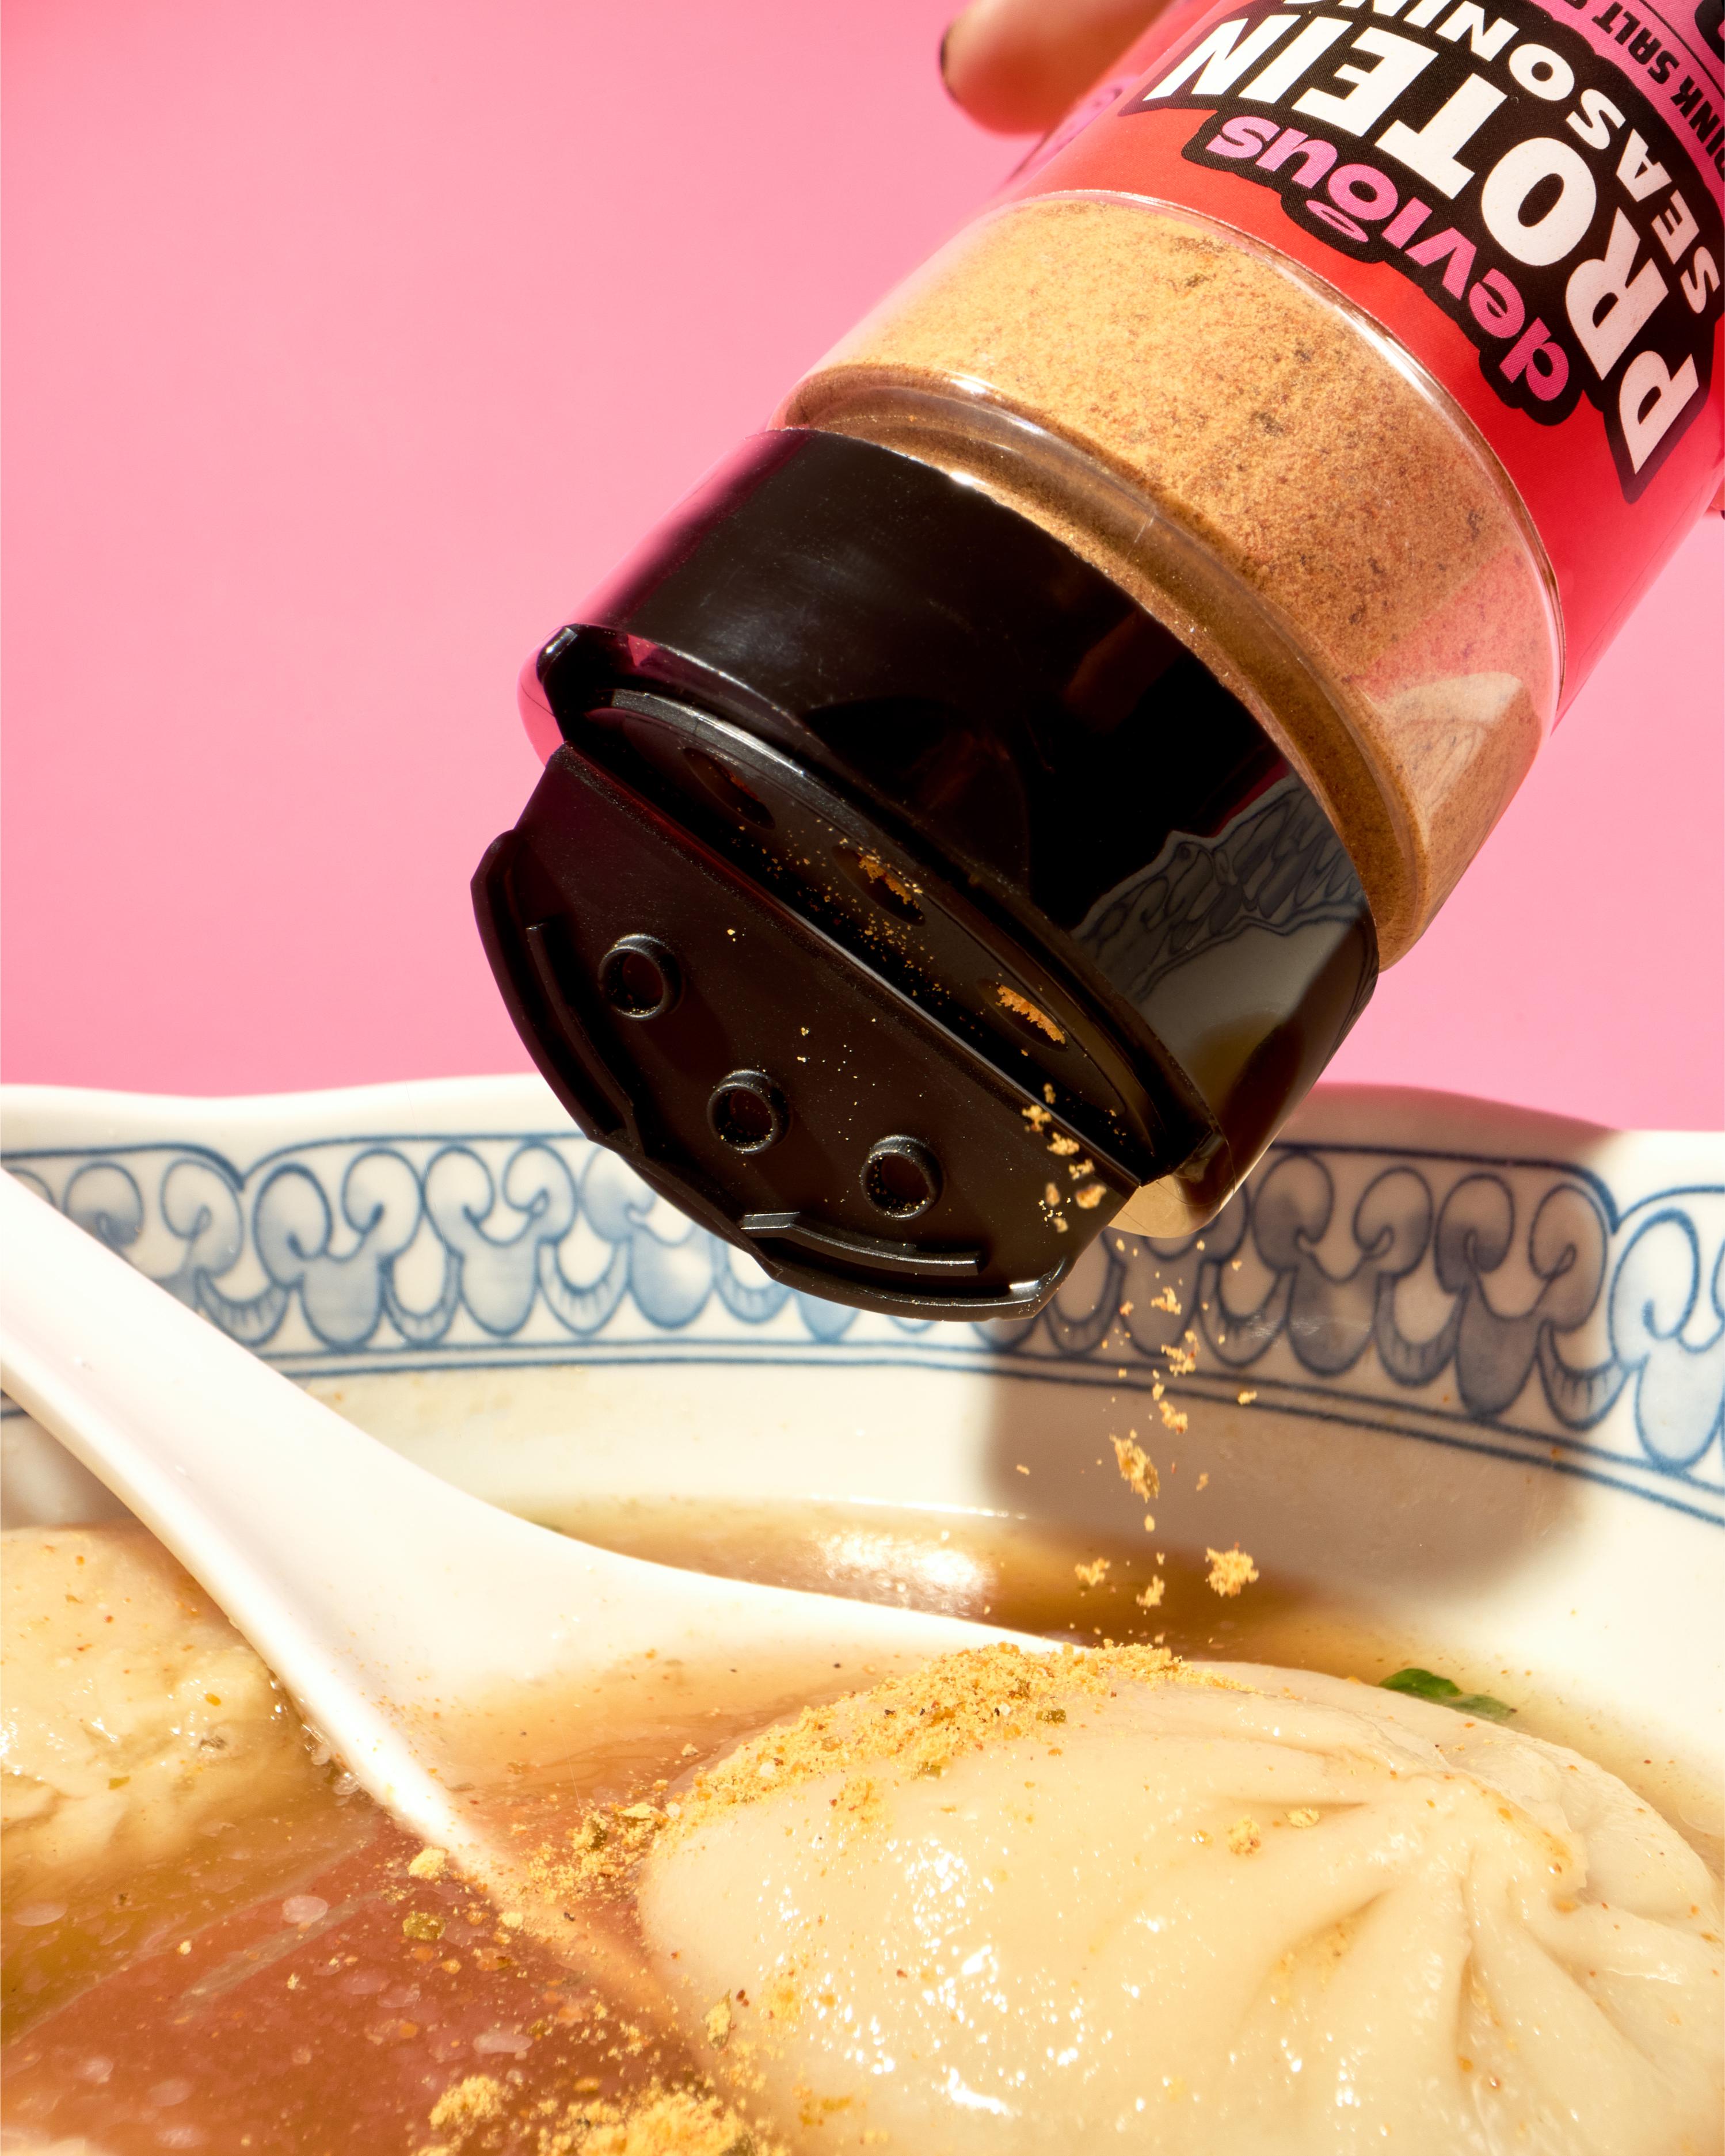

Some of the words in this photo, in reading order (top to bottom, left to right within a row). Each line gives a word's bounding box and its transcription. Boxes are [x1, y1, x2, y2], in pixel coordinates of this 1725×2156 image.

[1283, 0, 1720, 314] SEASONI
[1591, 2, 1680, 84] SALT
[1144, 14, 1699, 474] PROTEIN
[1206, 116, 1570, 401] devious
